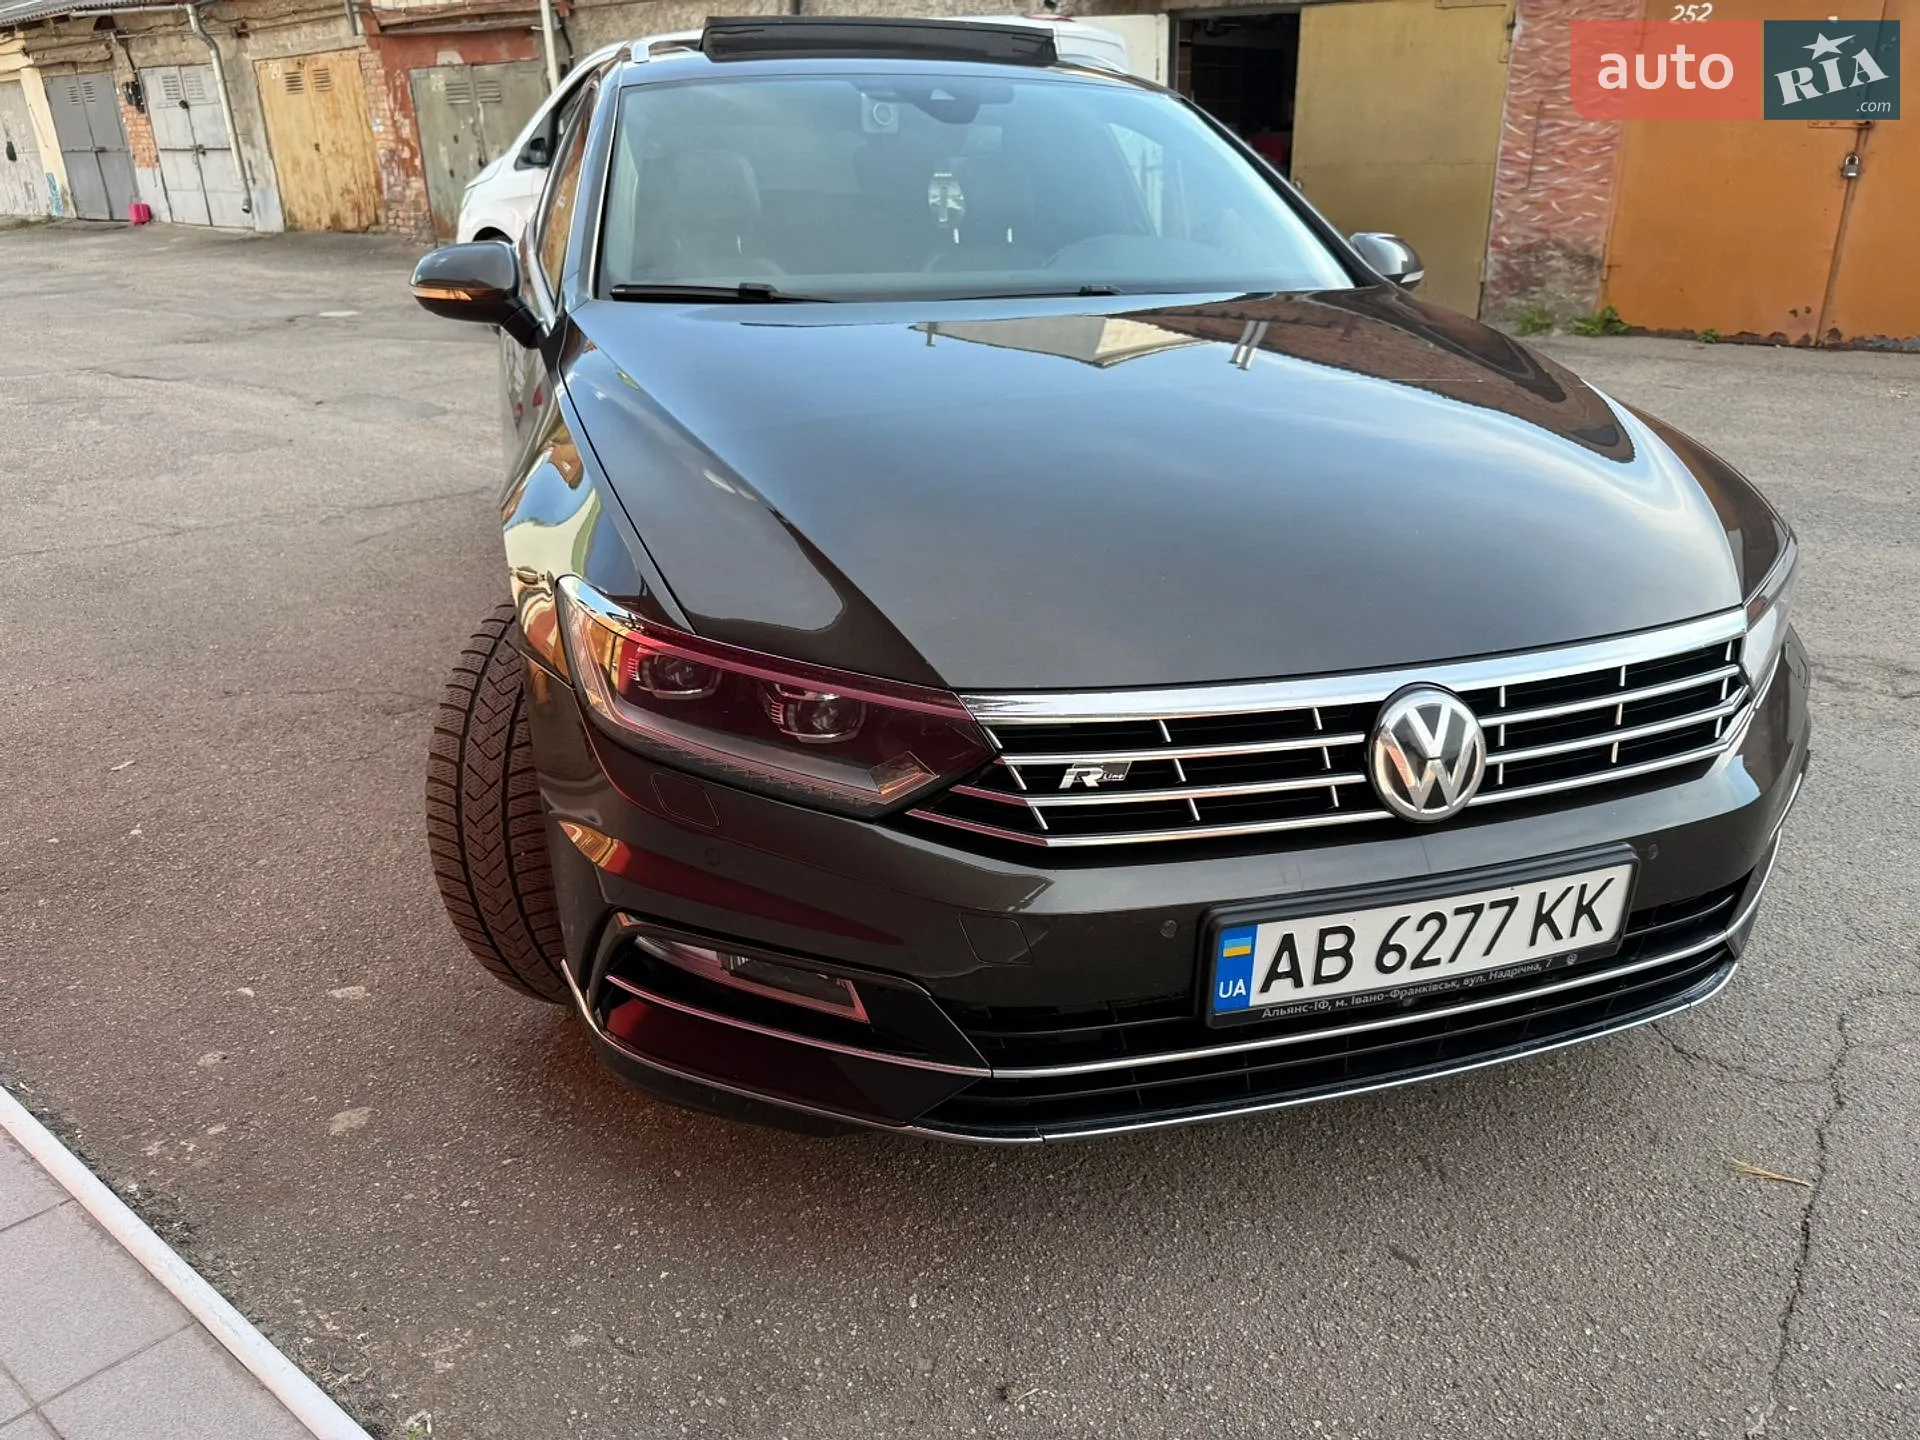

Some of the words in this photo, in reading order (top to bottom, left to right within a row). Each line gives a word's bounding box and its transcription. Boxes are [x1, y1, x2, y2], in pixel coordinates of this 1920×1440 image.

[1669, 3, 1713, 25] 252
[1258, 925, 1356, 994] AB
[1375, 896, 1519, 975] 6277
[1528, 877, 1616, 947] KK
[1218, 977, 1248, 999] UA
